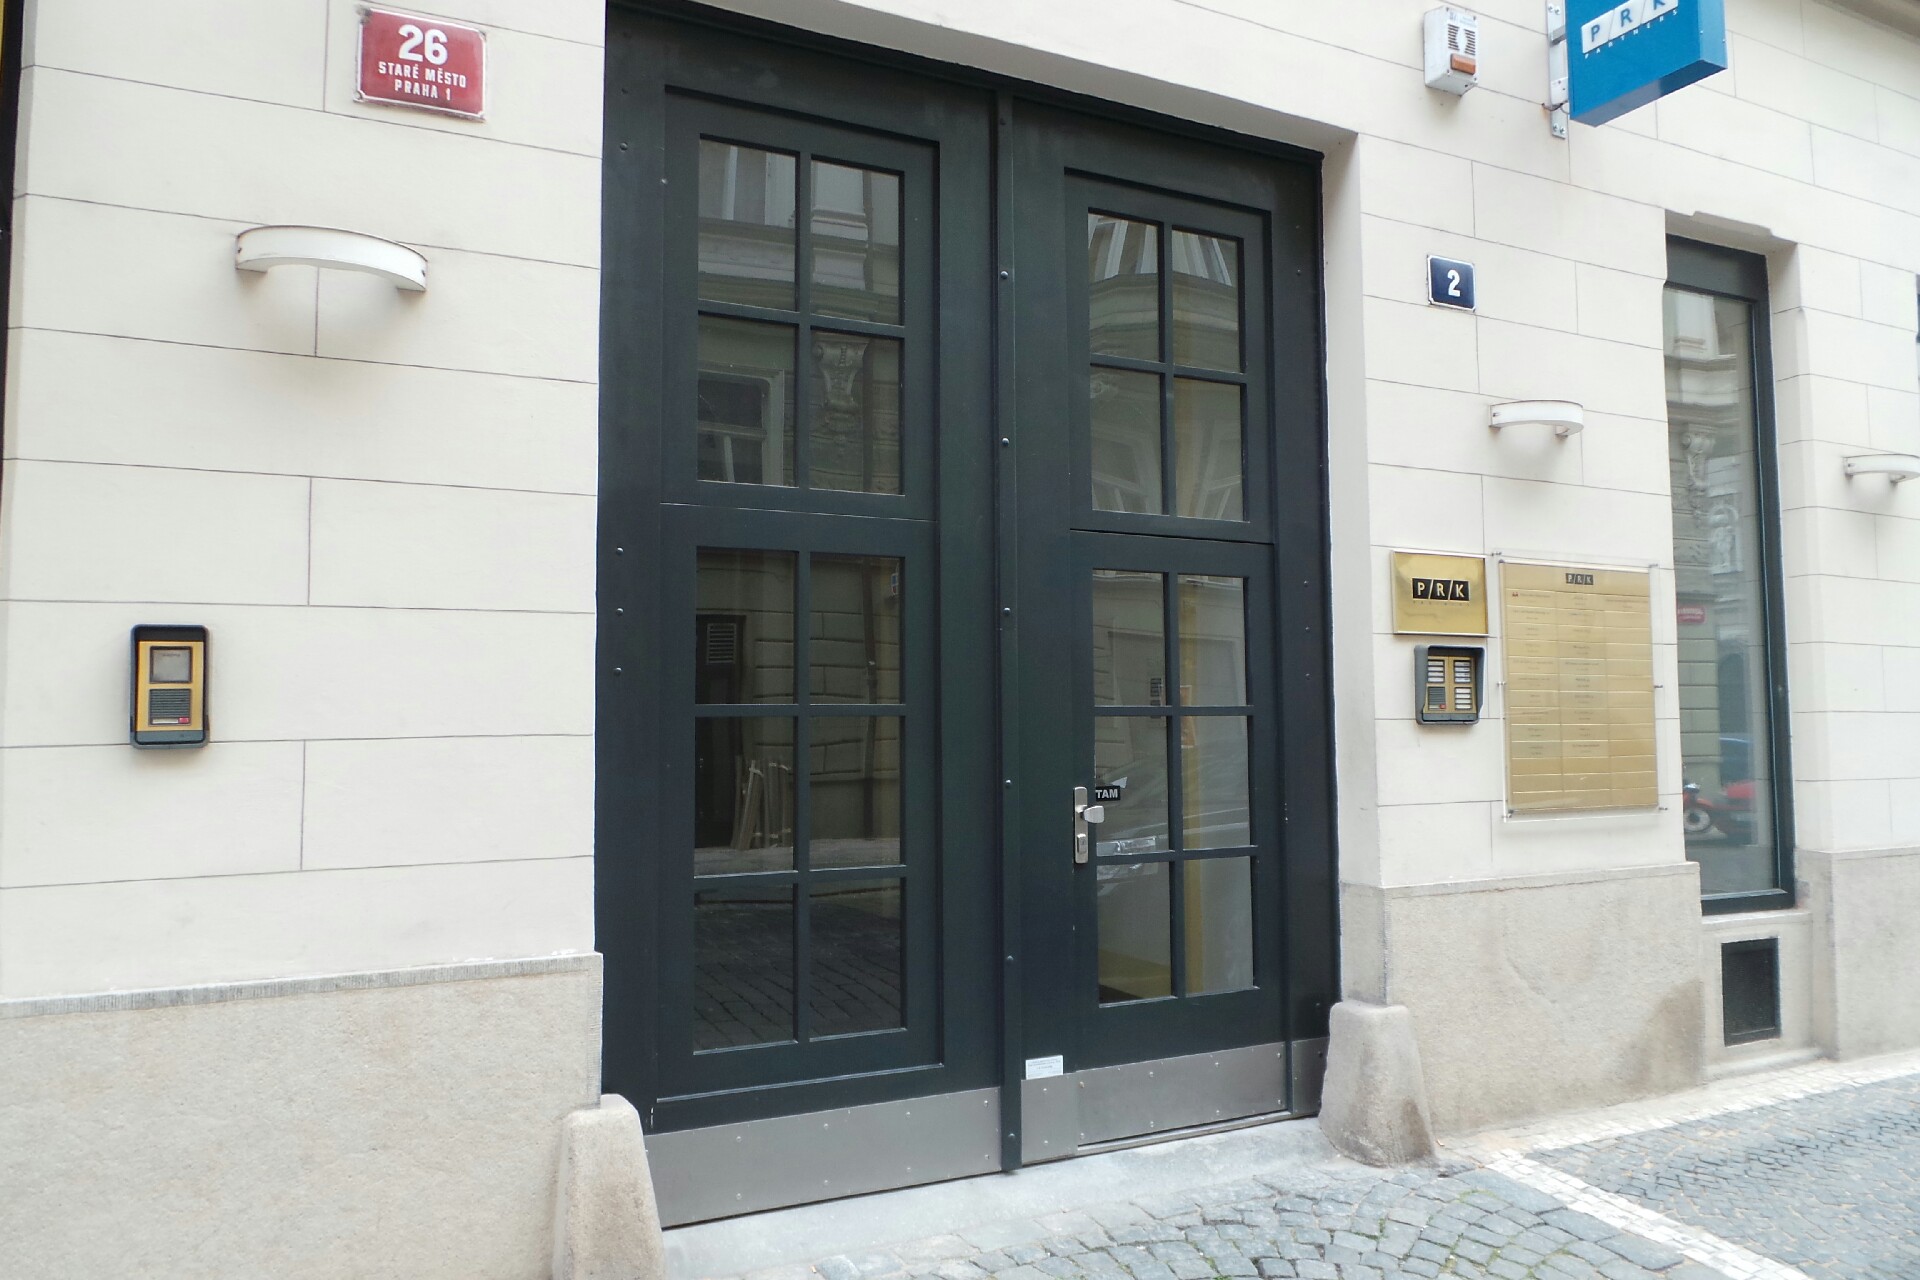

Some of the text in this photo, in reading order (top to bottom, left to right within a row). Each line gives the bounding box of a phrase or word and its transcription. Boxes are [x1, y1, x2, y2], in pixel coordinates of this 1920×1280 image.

[398, 24, 448, 65] 26
[378, 61, 467, 88] STARÉ MĚSTO
[394, 79, 451, 101] PRAHA 1
[1447, 269, 1461, 297] 2
[1095, 788, 1118, 799] TAM
